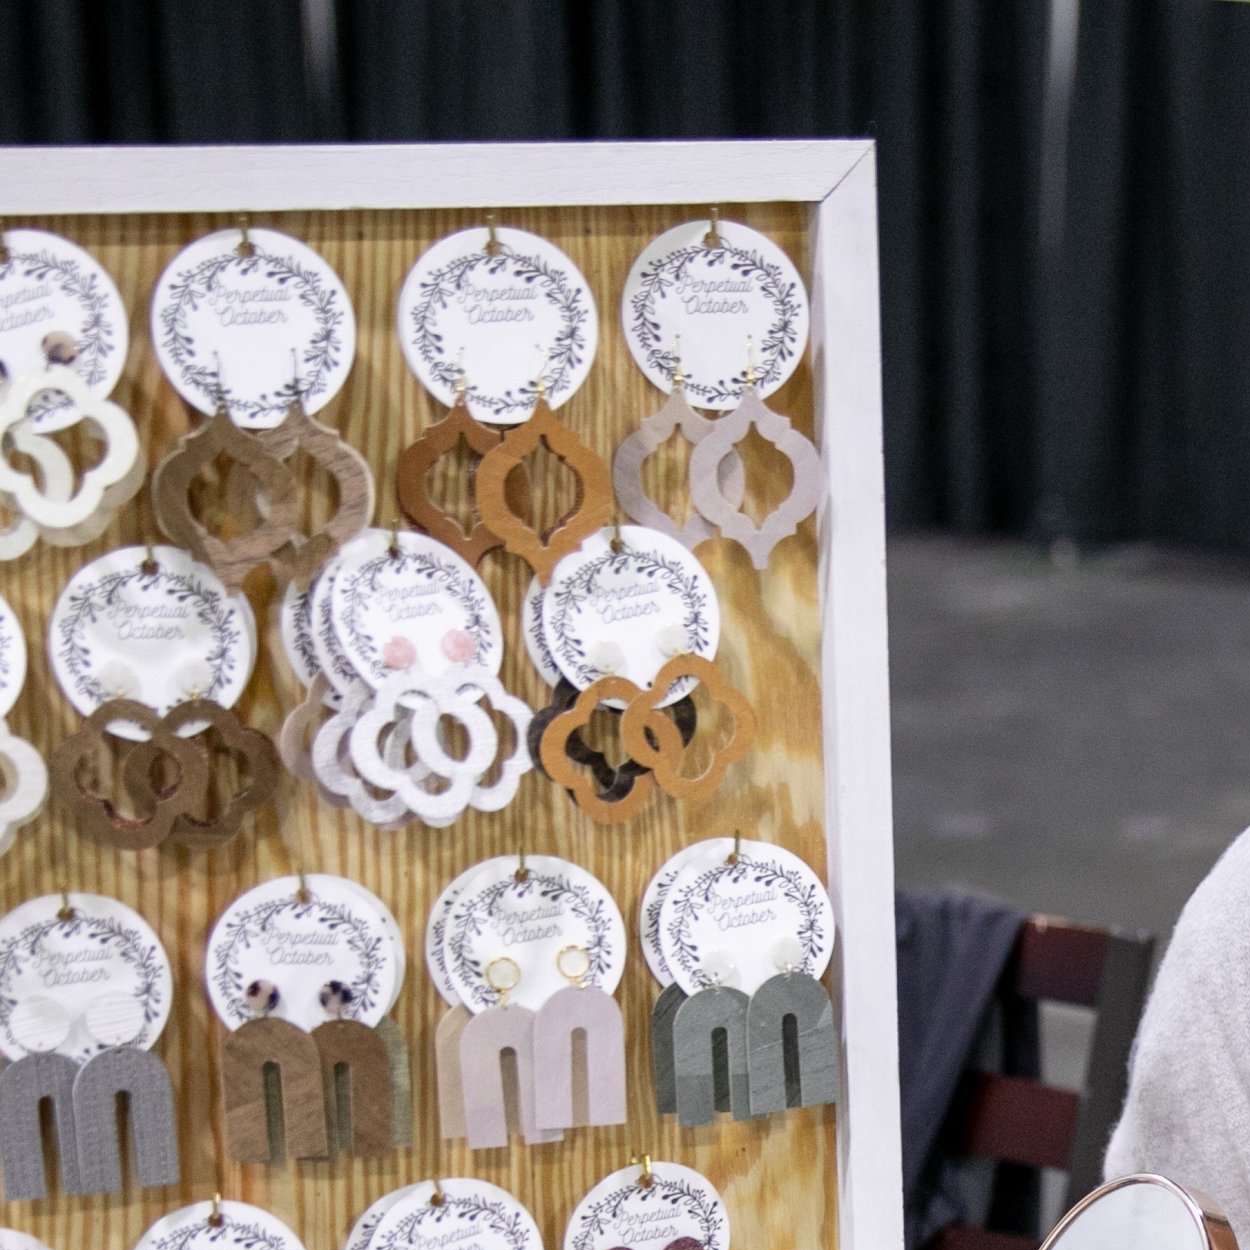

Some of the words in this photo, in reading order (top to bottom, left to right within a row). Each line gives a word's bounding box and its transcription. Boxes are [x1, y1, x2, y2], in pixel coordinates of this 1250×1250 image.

[456, 285, 538, 305] Perpetual
[675, 275, 754, 295] Perpetual
[463, 305, 534, 325] October
[681, 295, 749, 315] October
[706, 888, 779, 914] Perpetual
[713, 909, 777, 931] October
[613, 1205, 681, 1228] Perpetual
[618, 1225, 680, 1245] October
